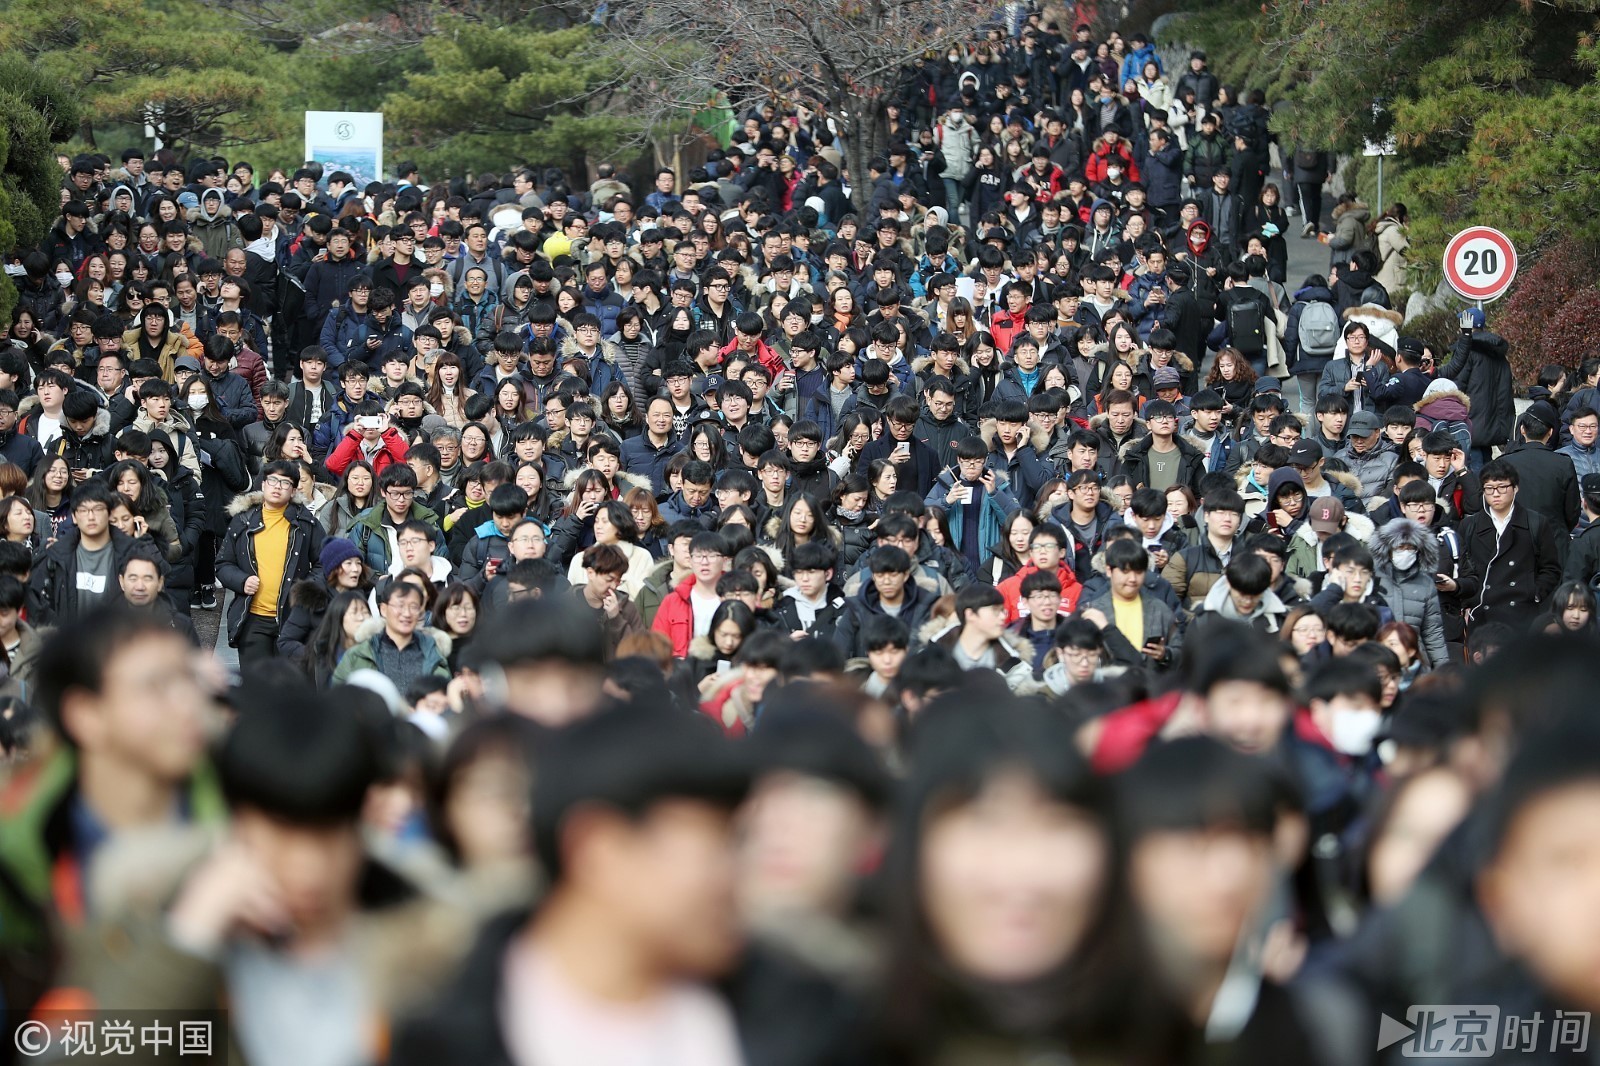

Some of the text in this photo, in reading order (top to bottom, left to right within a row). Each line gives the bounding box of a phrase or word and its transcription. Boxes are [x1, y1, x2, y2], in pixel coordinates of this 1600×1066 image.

[980, 174, 1000, 186] GAP
[1463, 249, 1498, 276] 20
[1156, 461, 1166, 472] T
[1321, 508, 1330, 520] B
